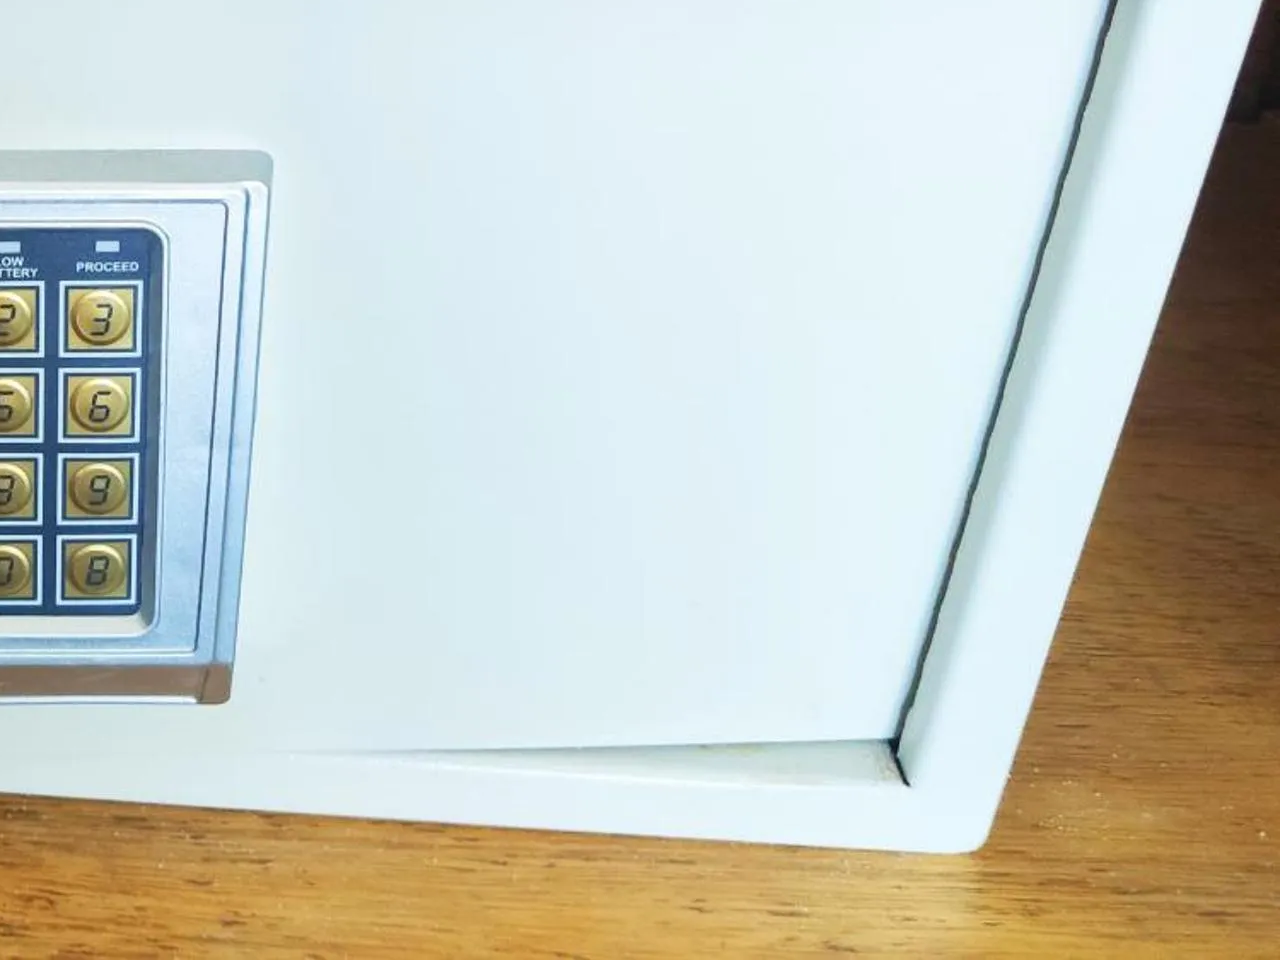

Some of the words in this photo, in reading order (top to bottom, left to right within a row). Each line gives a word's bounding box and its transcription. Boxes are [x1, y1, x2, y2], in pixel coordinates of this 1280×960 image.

[76, 261, 139, 273] PROCEED
[91, 304, 114, 337] 3
[88, 391, 111, 423] 6
[89, 475, 112, 506] 9
